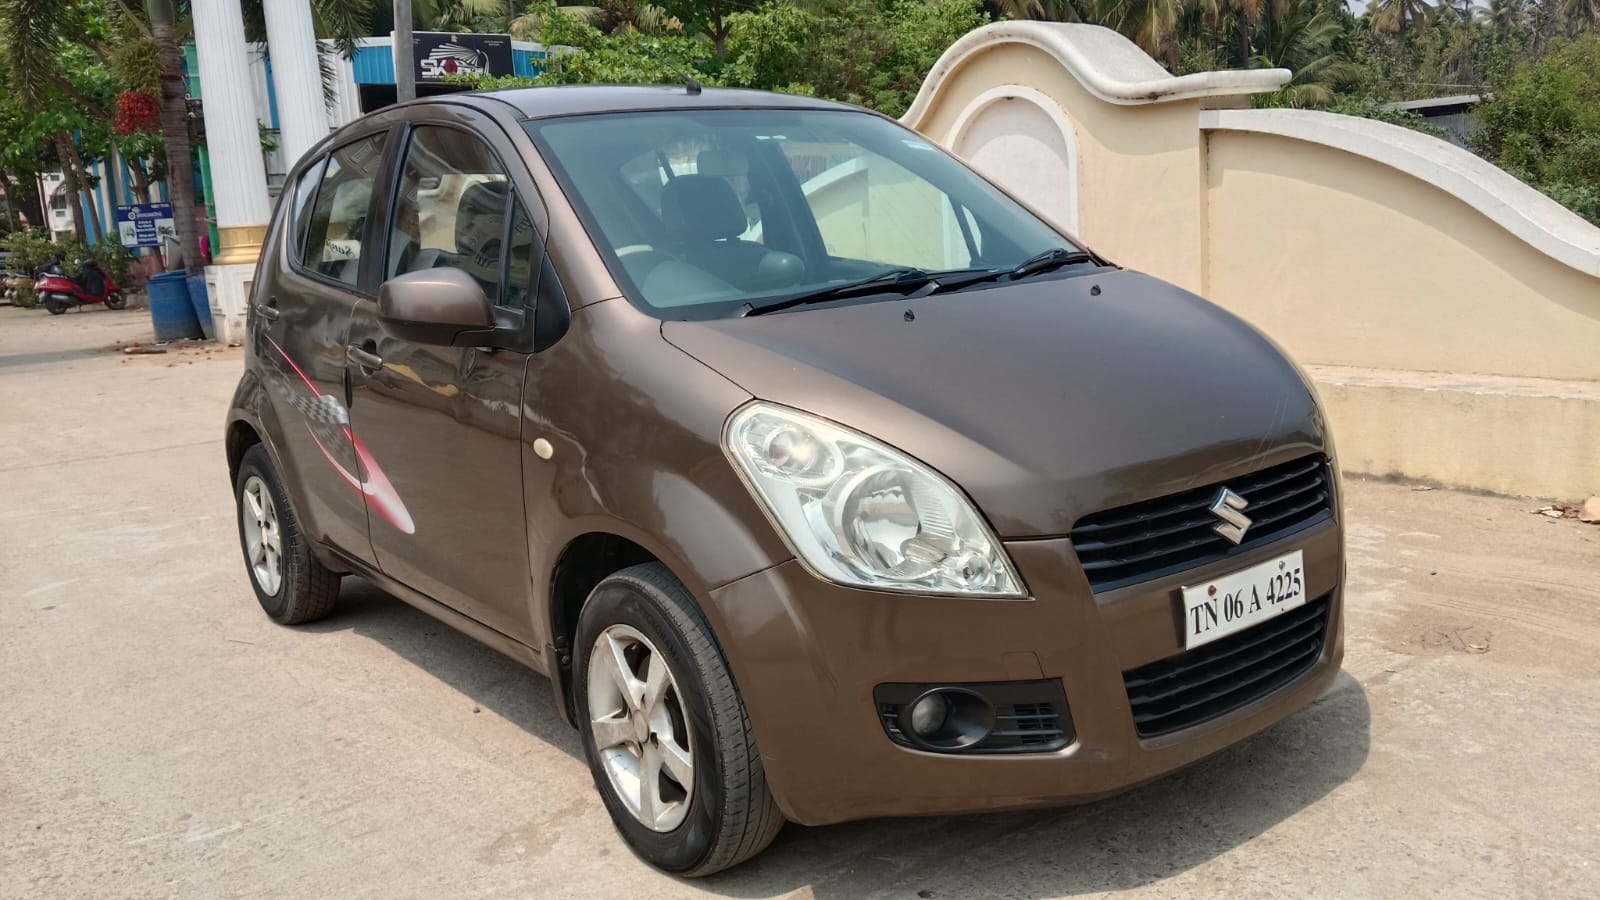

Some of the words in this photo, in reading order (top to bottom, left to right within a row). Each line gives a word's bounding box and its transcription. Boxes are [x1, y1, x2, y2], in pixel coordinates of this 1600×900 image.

[1190, 597, 1218, 635] TN
[1224, 588, 1244, 623] 06
[1249, 584, 1262, 613] A
[1266, 567, 1301, 605] 4225
